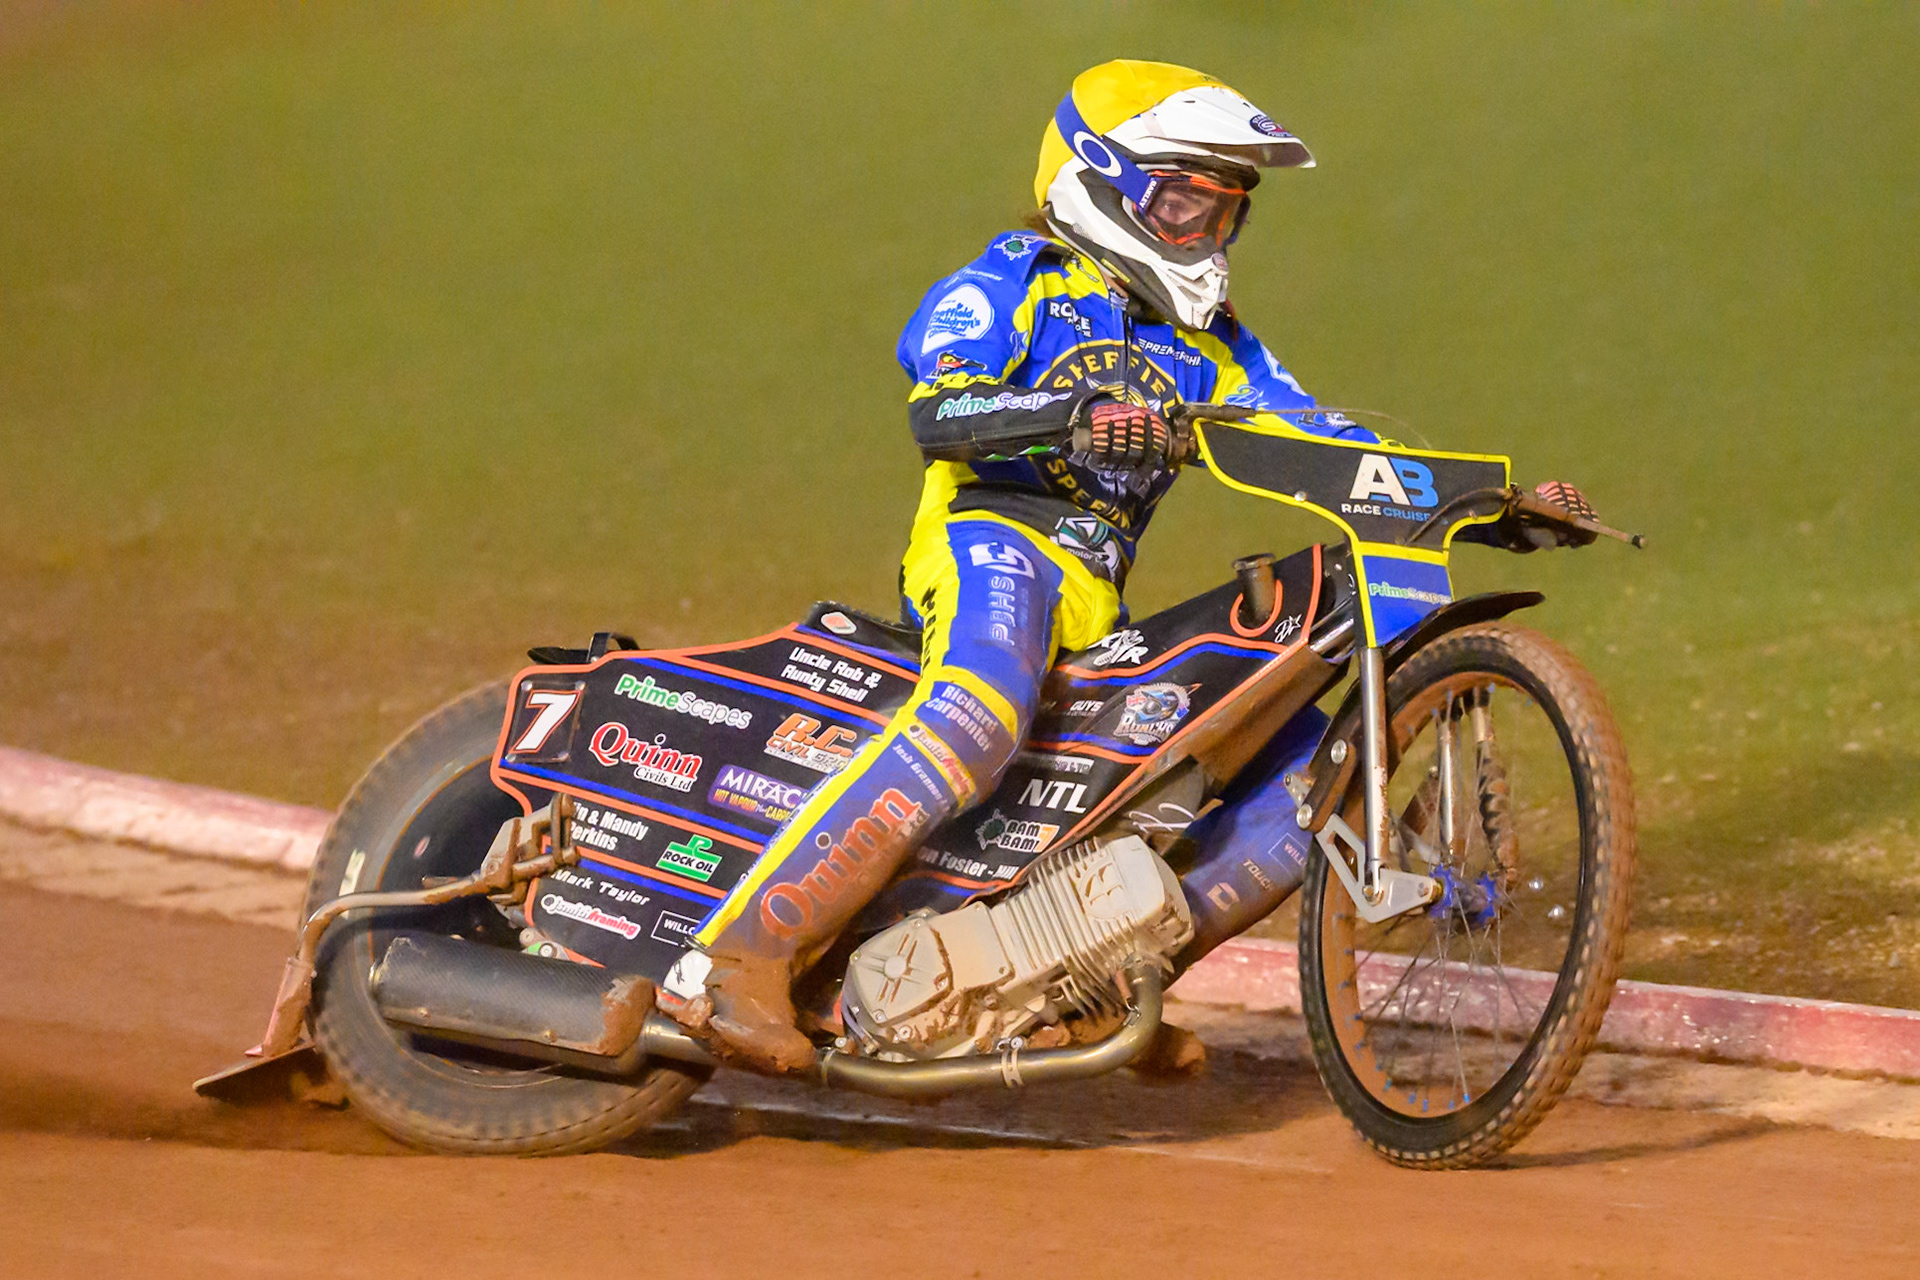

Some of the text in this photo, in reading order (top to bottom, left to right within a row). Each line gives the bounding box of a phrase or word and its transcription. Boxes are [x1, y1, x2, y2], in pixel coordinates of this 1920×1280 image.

[1350, 453, 1439, 508] AB
[1341, 503, 1382, 516] RACE
[781, 664, 868, 703] Aunty Shell
[789, 646, 882, 689] Uncle Rob &
[614, 673, 753, 729] PrimeScapes
[1070, 700, 1105, 712] GUYS
[508, 689, 583, 754] 7
[589, 722, 702, 781] Quinn
[767, 736, 810, 759] CIVIL
[892, 743, 913, 764] Josh
[635, 766, 693, 793] Civils Ltd
[720, 768, 804, 809] MIRAC
[1017, 778, 1088, 814] NTL
[713, 788, 729, 803] HOT
[729, 792, 759, 813] VAPOUR
[587, 810, 600, 826] &
[599, 811, 649, 841] Mandy
[1006, 821, 1040, 837] BAM
[662, 850, 714, 874] ROCK OIL
[760, 787, 923, 940] Quinn
[939, 850, 987, 877] Foster
[551, 869, 650, 906] Mark Taylor
